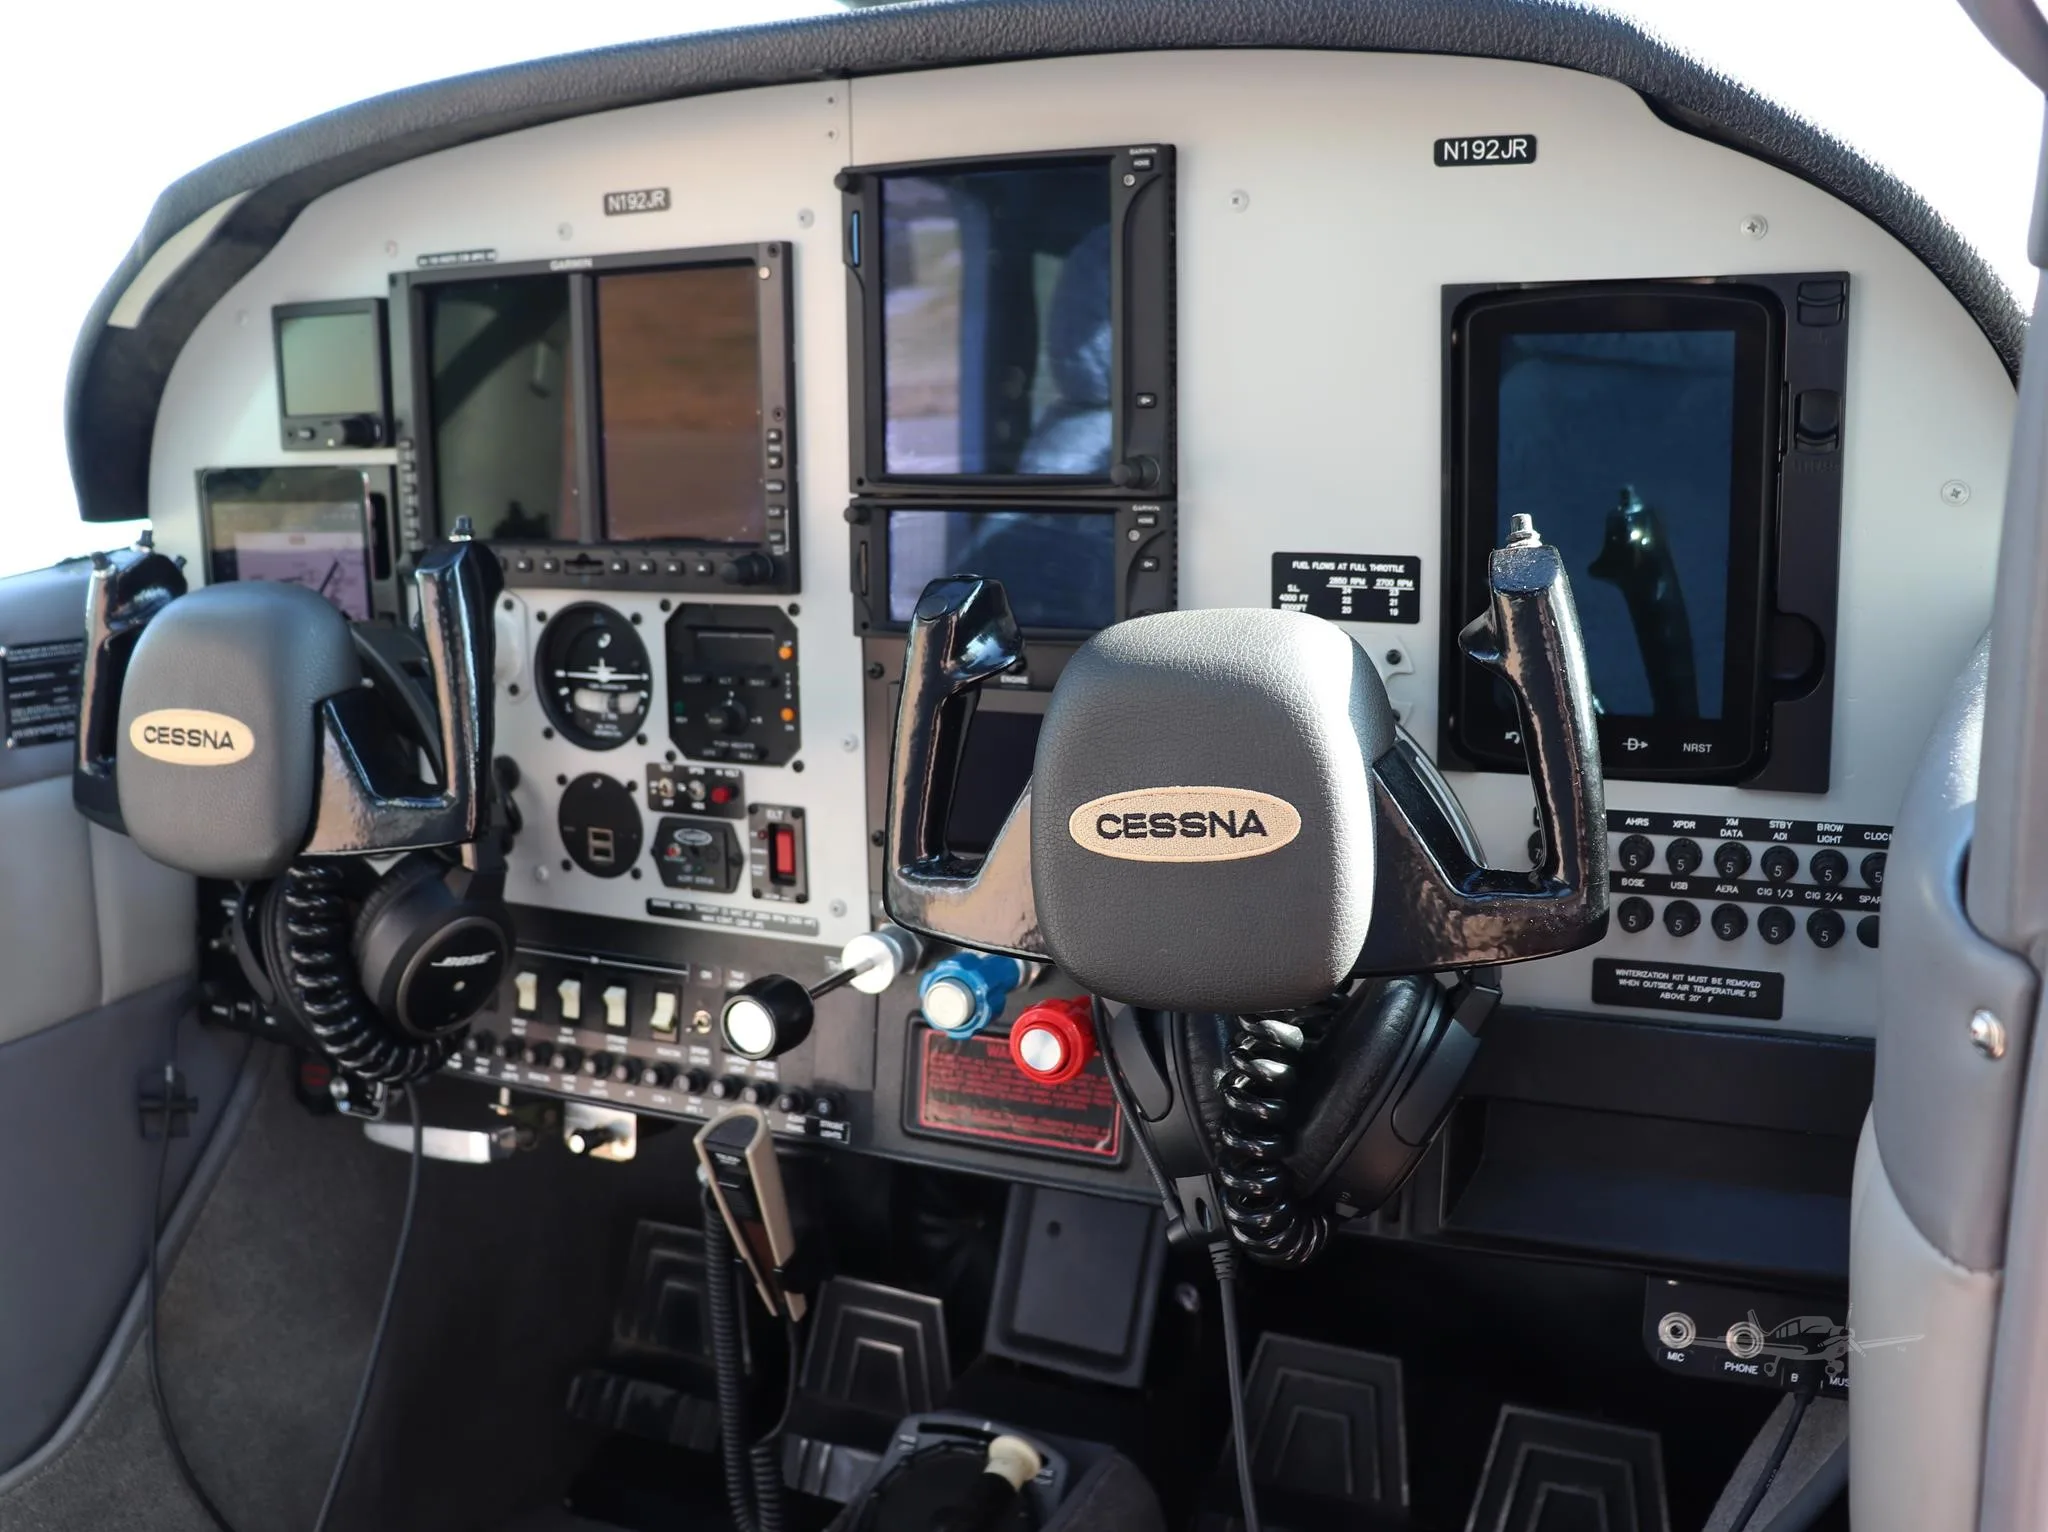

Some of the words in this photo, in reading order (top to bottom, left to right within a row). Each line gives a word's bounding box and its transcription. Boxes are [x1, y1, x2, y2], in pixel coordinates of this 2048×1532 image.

[1444, 138, 1528, 161] N192JR
[607, 190, 666, 212] N192JR
[1292, 560, 1310, 569] FUEL
[1337, 562, 1348, 571] AT
[1350, 563, 1367, 572] FULL
[1369, 563, 1405, 573] THROTTLE
[143, 725, 235, 751] CESSNA
[1683, 742, 1713, 753] NRST
[1096, 809, 1269, 840] CESSNA
[1625, 817, 1649, 827] AHRS
[1672, 819, 1696, 830] XPDR
[1726, 818, 1739, 826] XM
[1769, 820, 1793, 830] STBY
[1720, 828, 1743, 838] DATA
[1817, 823, 1844, 833] BROW
[1772, 832, 1788, 841] ADI
[1817, 834, 1842, 844] LIGHT
[1629, 855, 1637, 866] 5
[1676, 859, 1685, 871] 5
[1726, 862, 1734, 874] 5
[1773, 865, 1782, 877] 5
[1824, 870, 1832, 882] 5
[1621, 878, 1645, 888] BOSE
[1670, 881, 1688, 891] USB
[1715, 885, 1739, 895] AERA
[1757, 887, 1772, 897] CIG
[1777, 889, 1793, 898] 1/3
[1805, 891, 1821, 901] CIG
[1825, 892, 1843, 902] 2/4
[1628, 915, 1636, 926] 5
[1675, 919, 1683, 931] 5
[1723, 923, 1731, 935] 5
[1770, 927, 1779, 939] 5
[1821, 931, 1829, 942] 5
[1615, 968, 1669, 980] WINTERIZATION
[1687, 975, 1708, 984] MUST
[1711, 977, 1722, 985] BE
[1725, 978, 1761, 989] REMOVED
[1618, 979, 1640, 988] WHEN
[1642, 981, 1674, 991] OUTSIDE
[1677, 984, 1690, 992] AIR
[1692, 985, 1746, 998] TEMPERATURE
[1749, 990, 1757, 998] IS
[1660, 992, 1685, 1001] ABOVE
[1707, 996, 1714, 1004] F
[1667, 1351, 1685, 1362] MIC
[1724, 1361, 1759, 1375] PHONE
